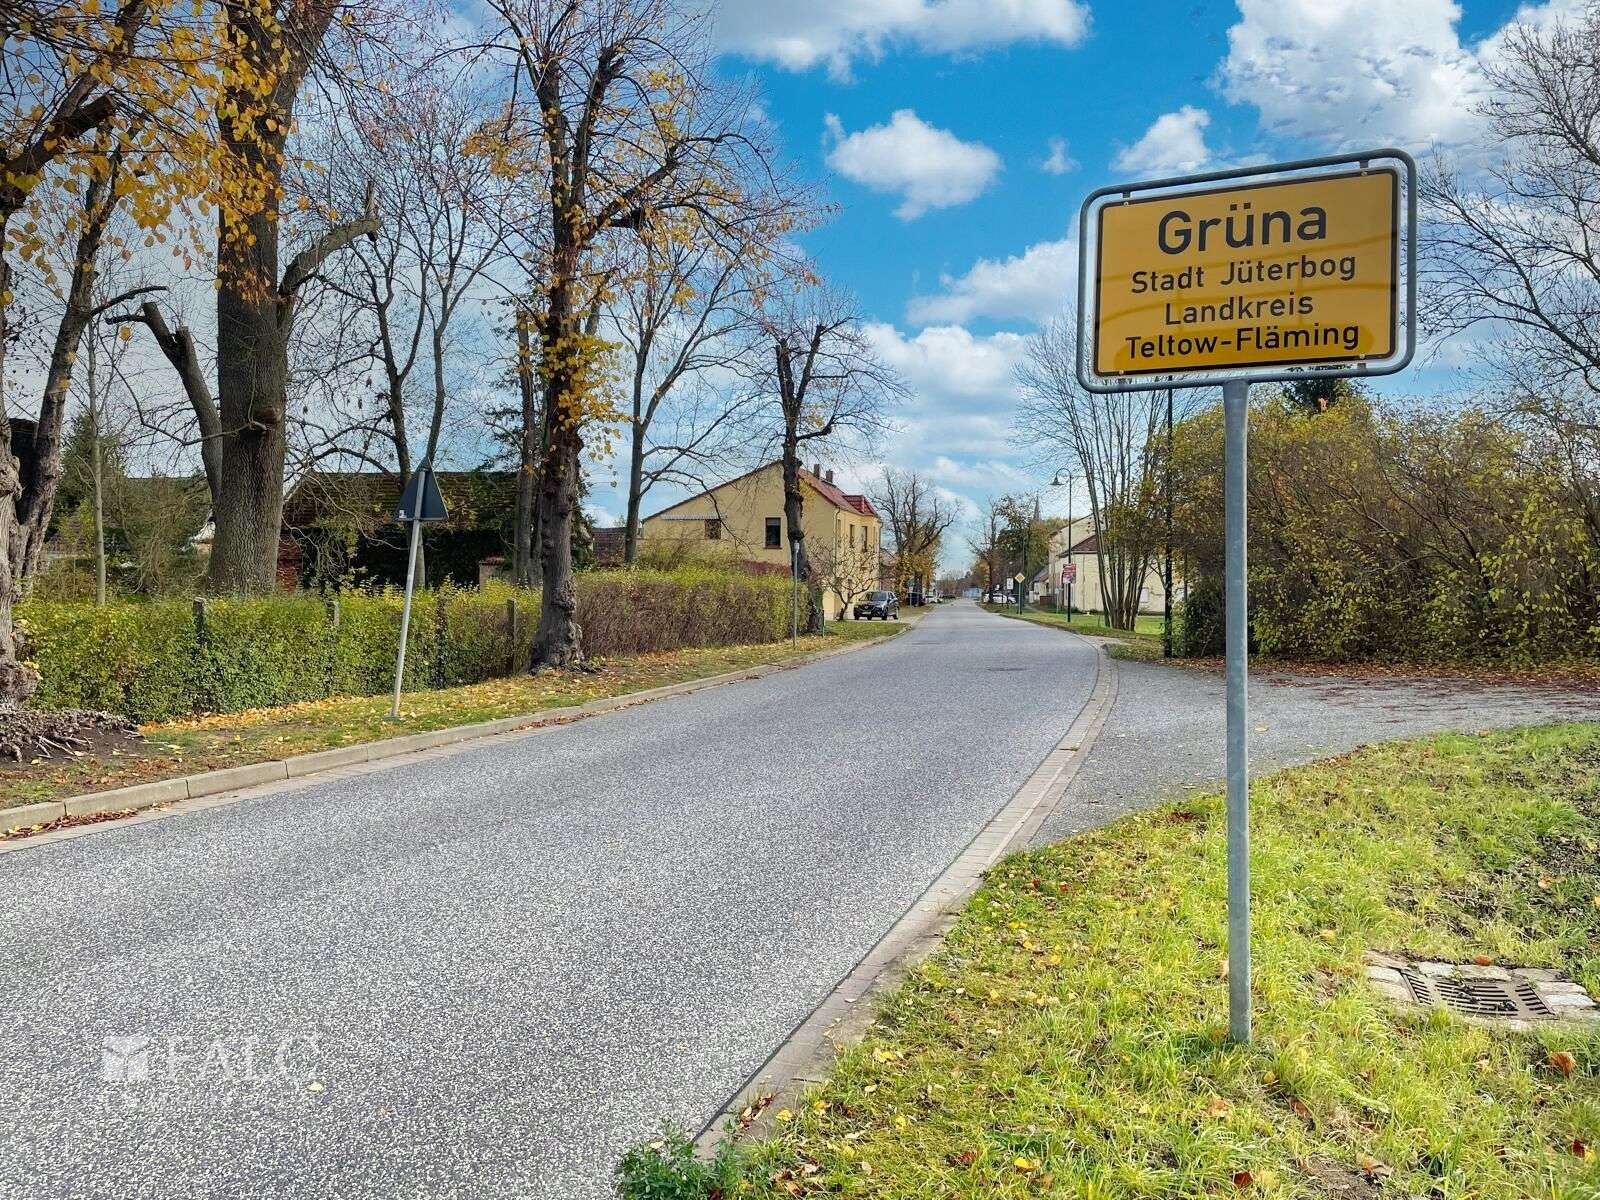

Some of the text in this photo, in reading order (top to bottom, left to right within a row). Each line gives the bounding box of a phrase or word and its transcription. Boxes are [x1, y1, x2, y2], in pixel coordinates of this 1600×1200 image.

[1158, 202, 1326, 254] Grüna
[1131, 255, 1356, 294] Stadt Jüterbog
[1165, 291, 1313, 325] Landkreis
[1125, 323, 1359, 359] Teltow-Fläming
